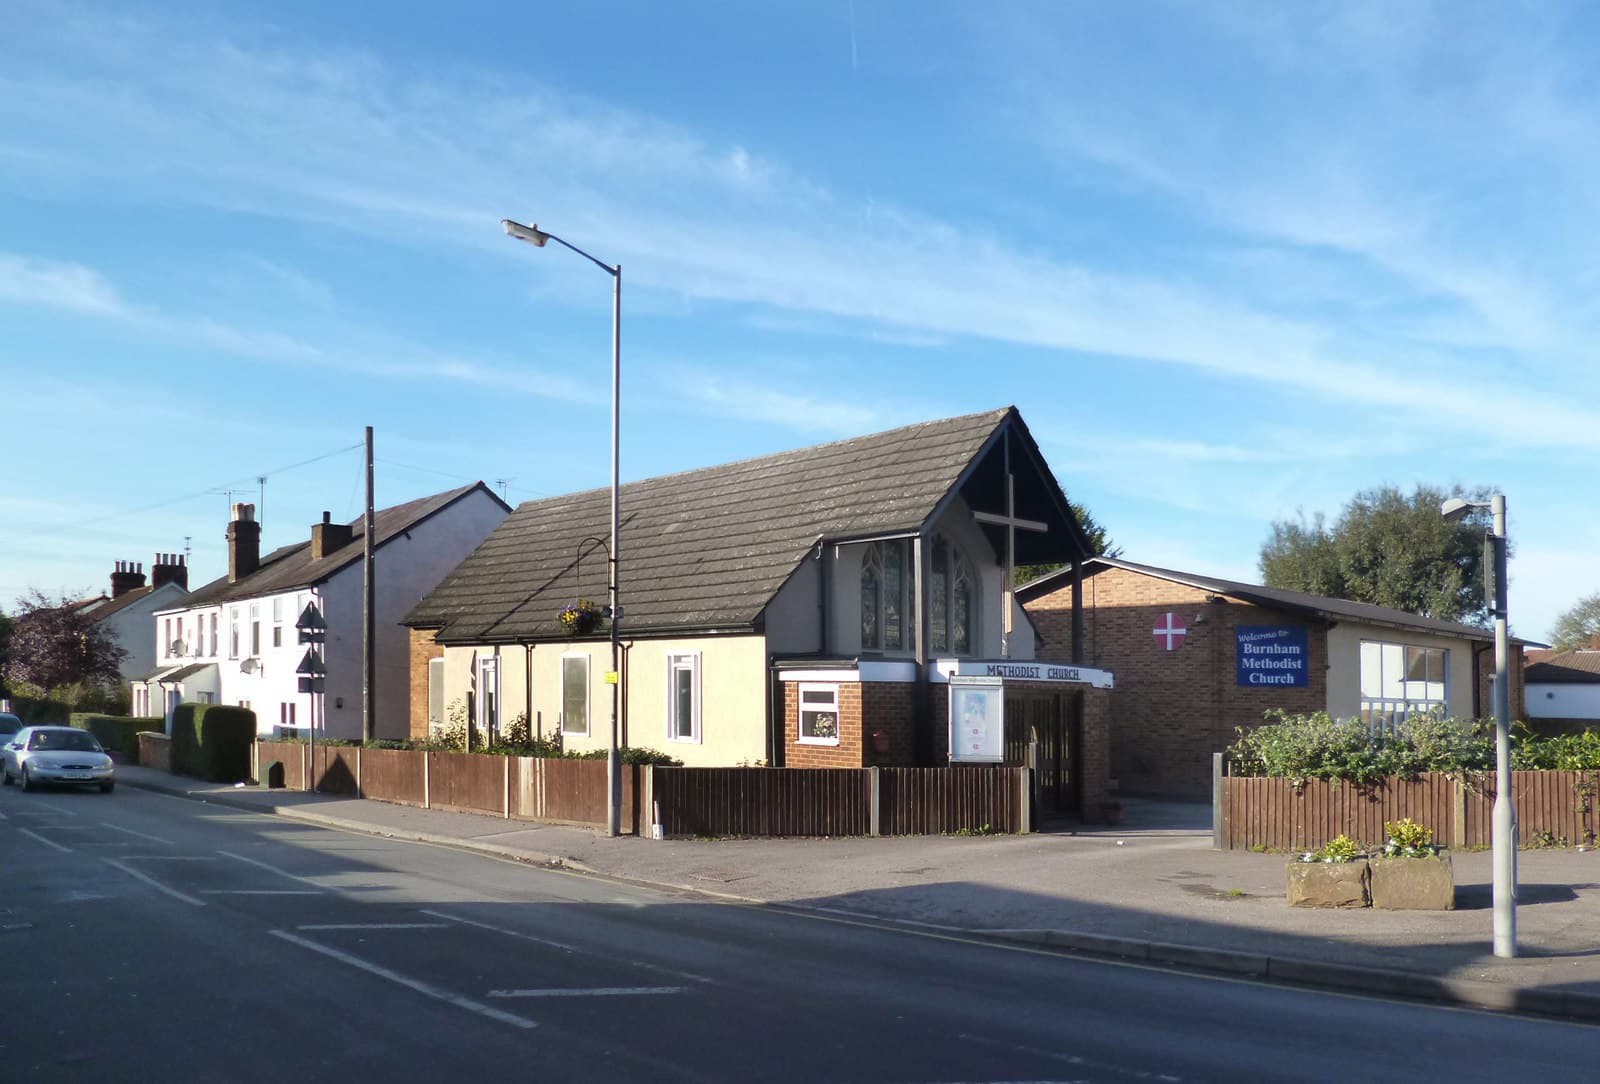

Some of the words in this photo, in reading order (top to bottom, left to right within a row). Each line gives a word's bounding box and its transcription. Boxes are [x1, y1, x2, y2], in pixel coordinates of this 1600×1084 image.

[1238, 632, 1277, 642] Welcome
[1243, 643, 1300, 654] Burnham
[1242, 658, 1302, 669] Methodist
[987, 665, 1040, 678] METHODIST
[1047, 668, 1081, 680] CHURCH
[1249, 673, 1295, 684] Church
